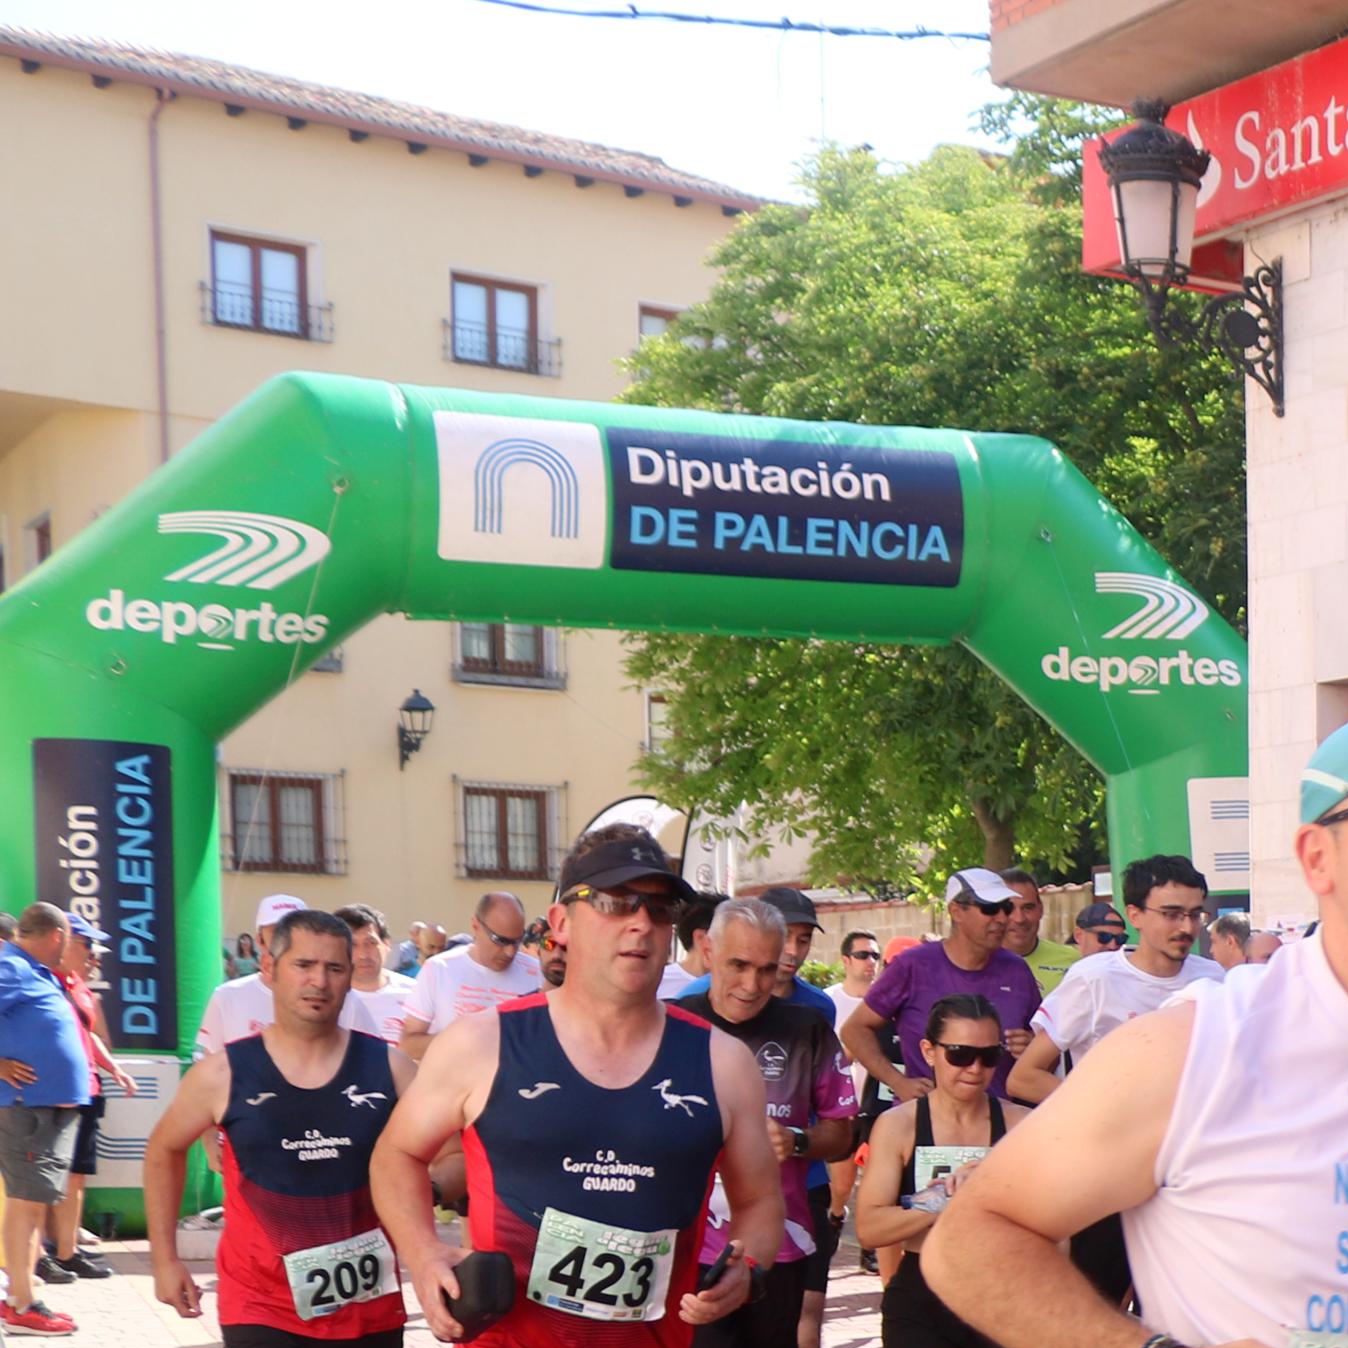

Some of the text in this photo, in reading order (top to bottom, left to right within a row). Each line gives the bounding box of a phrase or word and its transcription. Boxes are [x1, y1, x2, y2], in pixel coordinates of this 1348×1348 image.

[626, 446, 893, 501] Diputación
[630, 505, 952, 563] DE PALENCIA
[86, 588, 330, 645] deportes
[1041, 646, 1241, 693] deportes
[115, 754, 157, 1035] DE PALENCIA
[562, 1157, 656, 1178] Correcaminos
[583, 1177, 636, 1192] GUARDO
[307, 1254, 380, 1307] 209
[547, 1245, 654, 1308] 423
